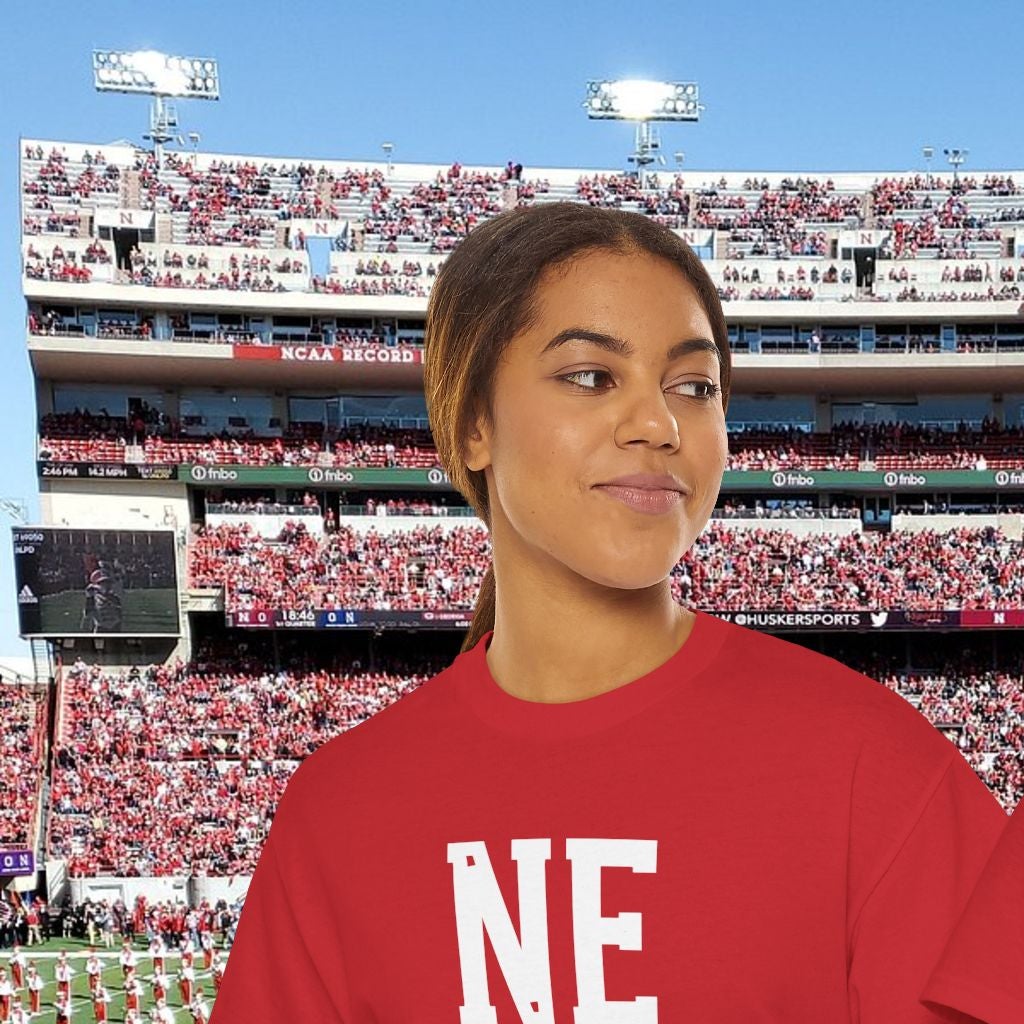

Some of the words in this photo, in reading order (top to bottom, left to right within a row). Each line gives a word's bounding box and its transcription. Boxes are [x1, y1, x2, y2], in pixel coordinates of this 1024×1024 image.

[120, 212, 133, 225] N
[315, 223, 328, 234] N
[860, 233, 872, 245] N
[281, 346, 334, 360] NCAA
[342, 348, 414, 362] RECORD
[62, 467, 78, 476] PM
[106, 468, 128, 477] MPH
[208, 467, 238, 481] fnbo
[324, 469, 354, 482] fnbo
[787, 474, 815, 486] fnbo
[899, 474, 926, 486] fnbo
[238, 611, 250, 622] N
[281, 610, 315, 621] 18:46
[735, 613, 860, 626] @HUSKERSPORTS
[993, 612, 1005, 624] N
